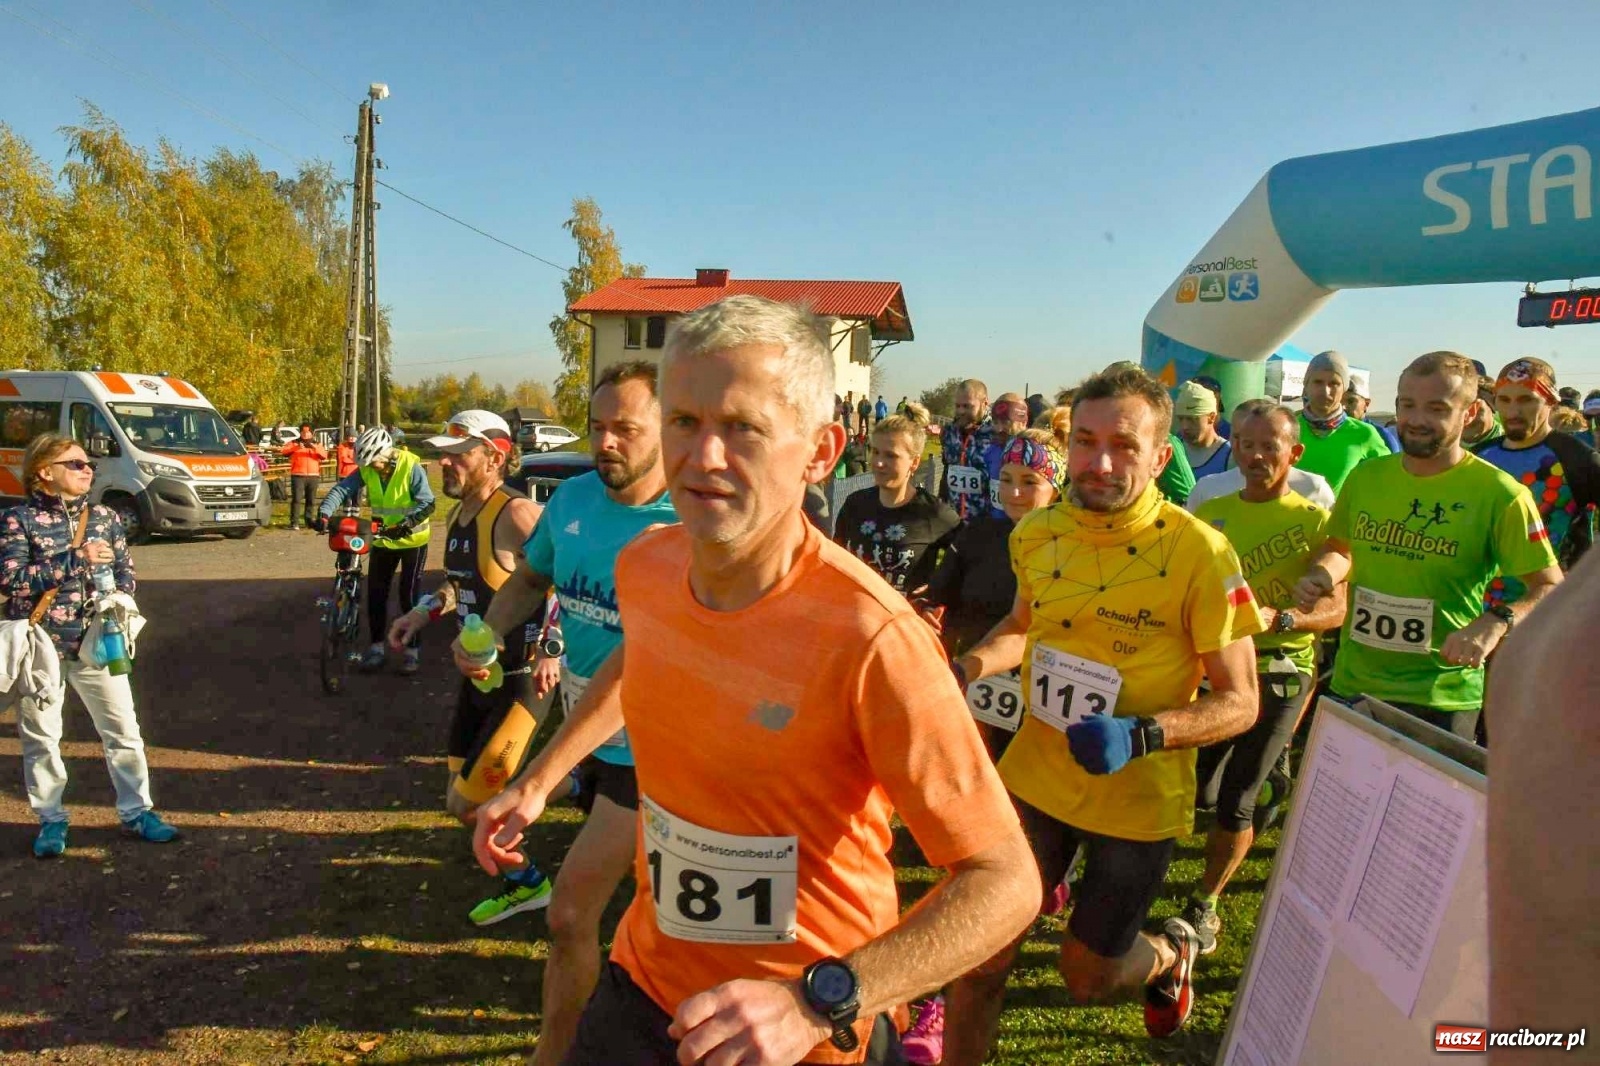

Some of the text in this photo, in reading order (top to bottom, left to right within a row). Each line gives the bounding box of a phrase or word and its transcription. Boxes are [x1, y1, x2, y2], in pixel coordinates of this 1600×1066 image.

[1421, 145, 1592, 236] STA
[950, 475, 979, 489] 218
[1354, 510, 1459, 557] Radlinioki
[558, 593, 621, 625] warsaw
[1354, 607, 1425, 643] 208
[973, 683, 1018, 718] 39
[676, 832, 789, 860] www.personalbest.pl
[648, 849, 772, 925] 181
